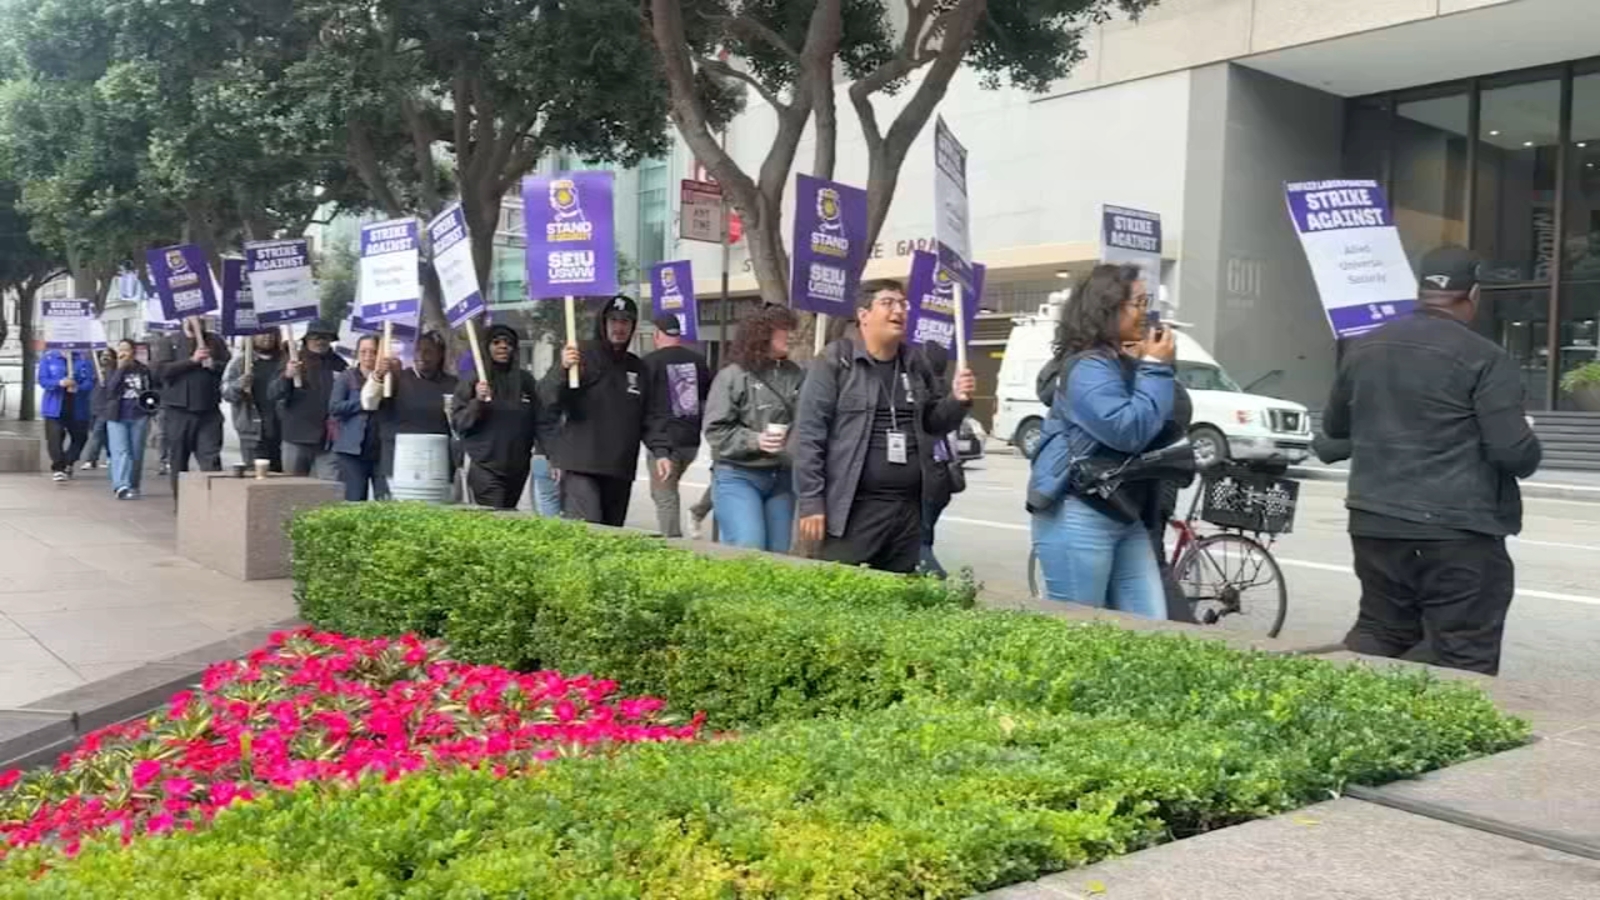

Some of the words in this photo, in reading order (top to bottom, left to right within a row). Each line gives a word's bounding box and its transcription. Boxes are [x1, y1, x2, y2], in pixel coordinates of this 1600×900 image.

[1305, 188, 1373, 210] STRIKE
[546, 221, 592, 234] STAND
[1113, 215, 1153, 234] STRIKE
[1306, 208, 1385, 230] AGAINST
[369, 225, 409, 242] STRIKE
[811, 232, 849, 250] STAND
[1110, 231, 1158, 251] AGAINST
[256, 245, 299, 260] STRIKE
[365, 237, 413, 256] AGAINST
[896, 237, 938, 256] GARA
[254, 255, 304, 270] AGAINST
[547, 250, 595, 268] SEIU
[548, 266, 595, 280] USWW
[809, 262, 846, 285] SEIU
[917, 318, 954, 335] SEIU
